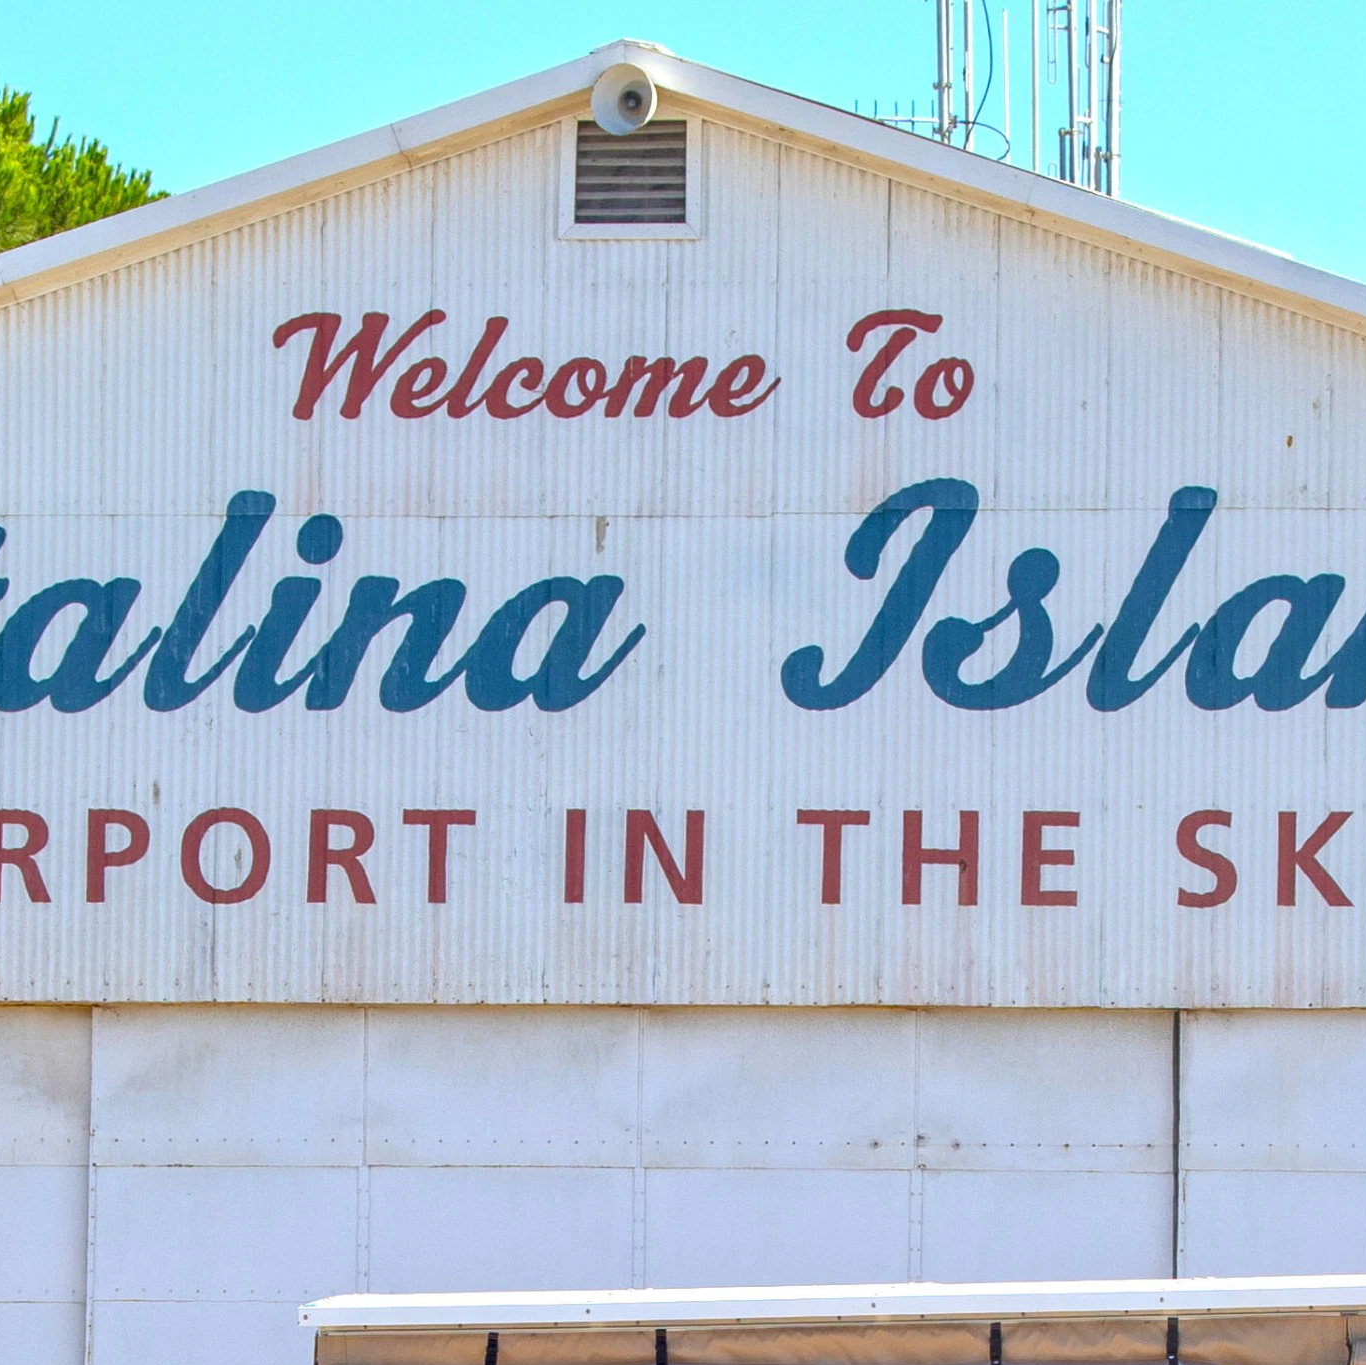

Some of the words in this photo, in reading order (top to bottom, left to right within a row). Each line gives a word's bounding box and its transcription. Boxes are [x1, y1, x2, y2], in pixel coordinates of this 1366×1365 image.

[274, 310, 780, 421] Welcome
[848, 310, 973, 421] To
[565, 809, 704, 903] IN
[797, 809, 1079, 905] THE
